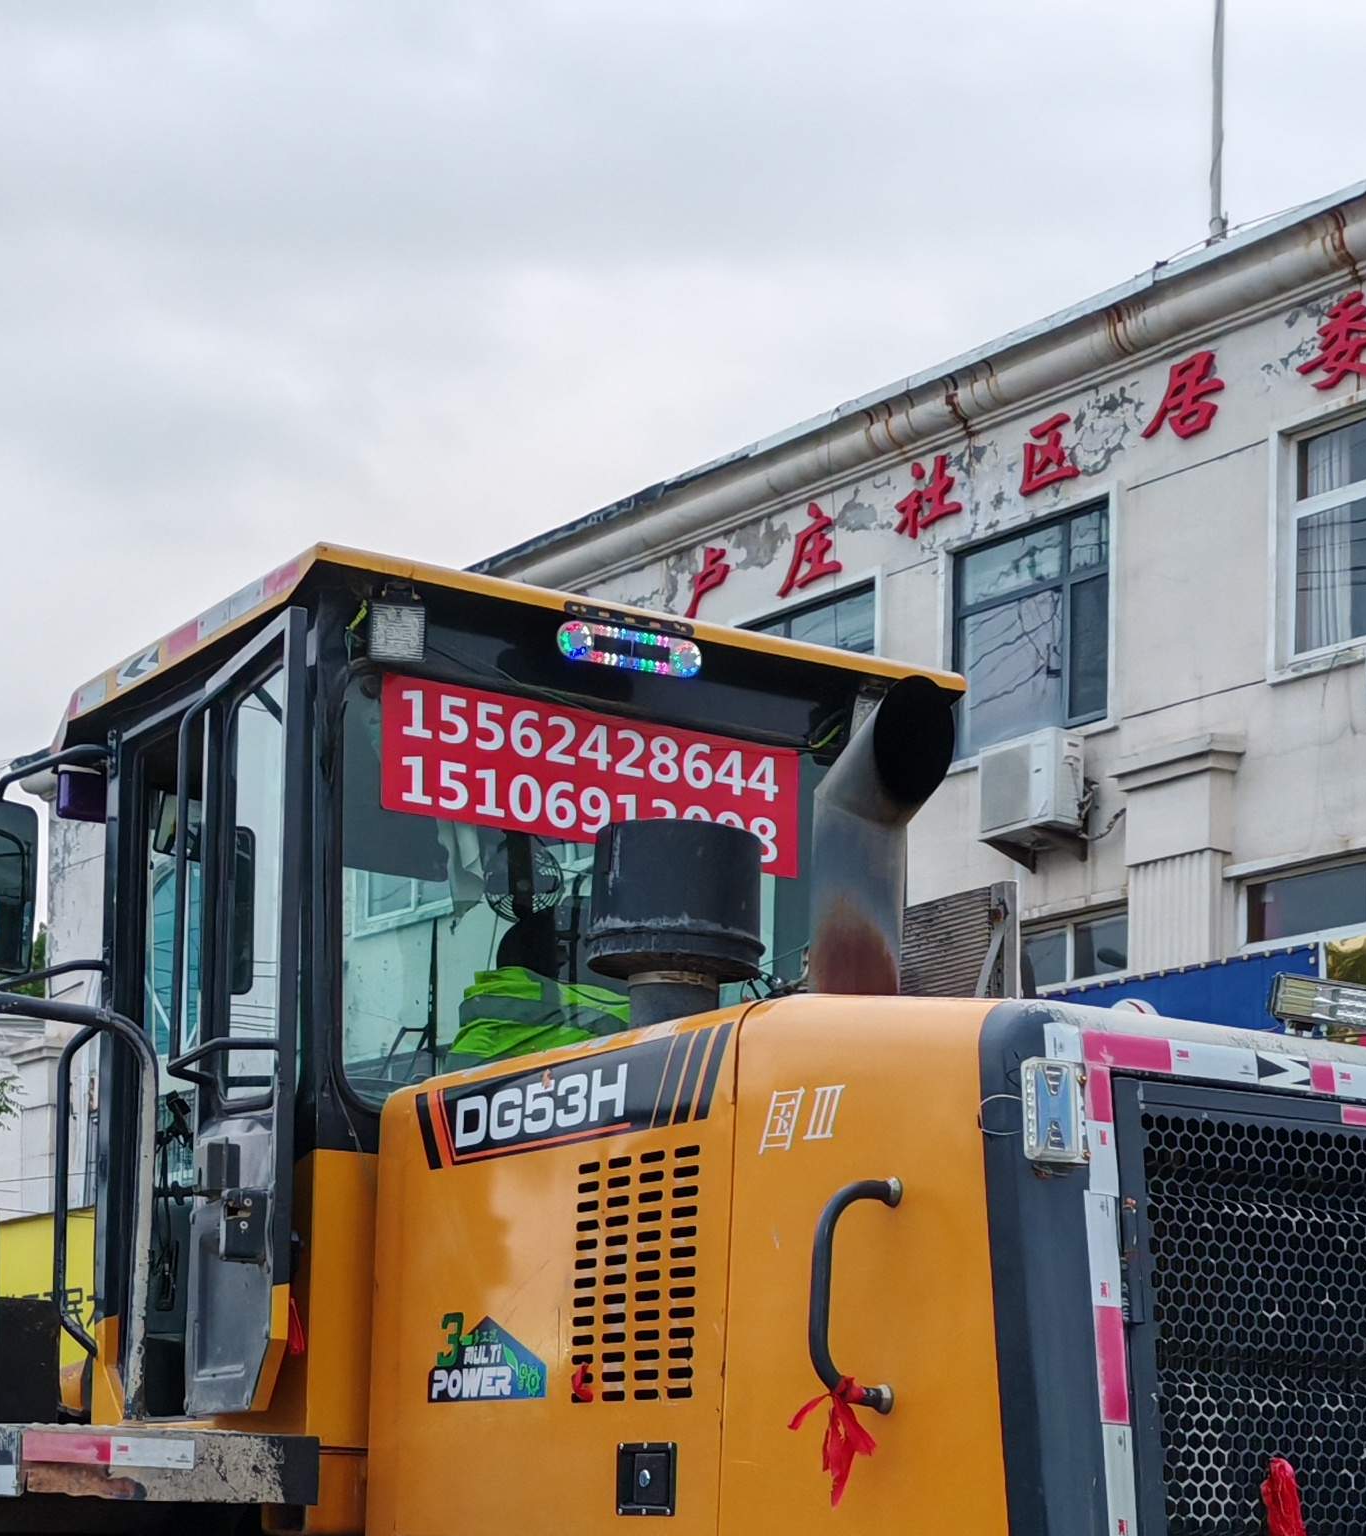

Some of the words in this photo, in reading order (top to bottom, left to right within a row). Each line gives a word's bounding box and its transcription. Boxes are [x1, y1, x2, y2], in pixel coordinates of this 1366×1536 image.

[401, 689, 779, 802] 15562428644
[453, 1062, 629, 1149] DG53H
[431, 1366, 512, 1399] POWER
